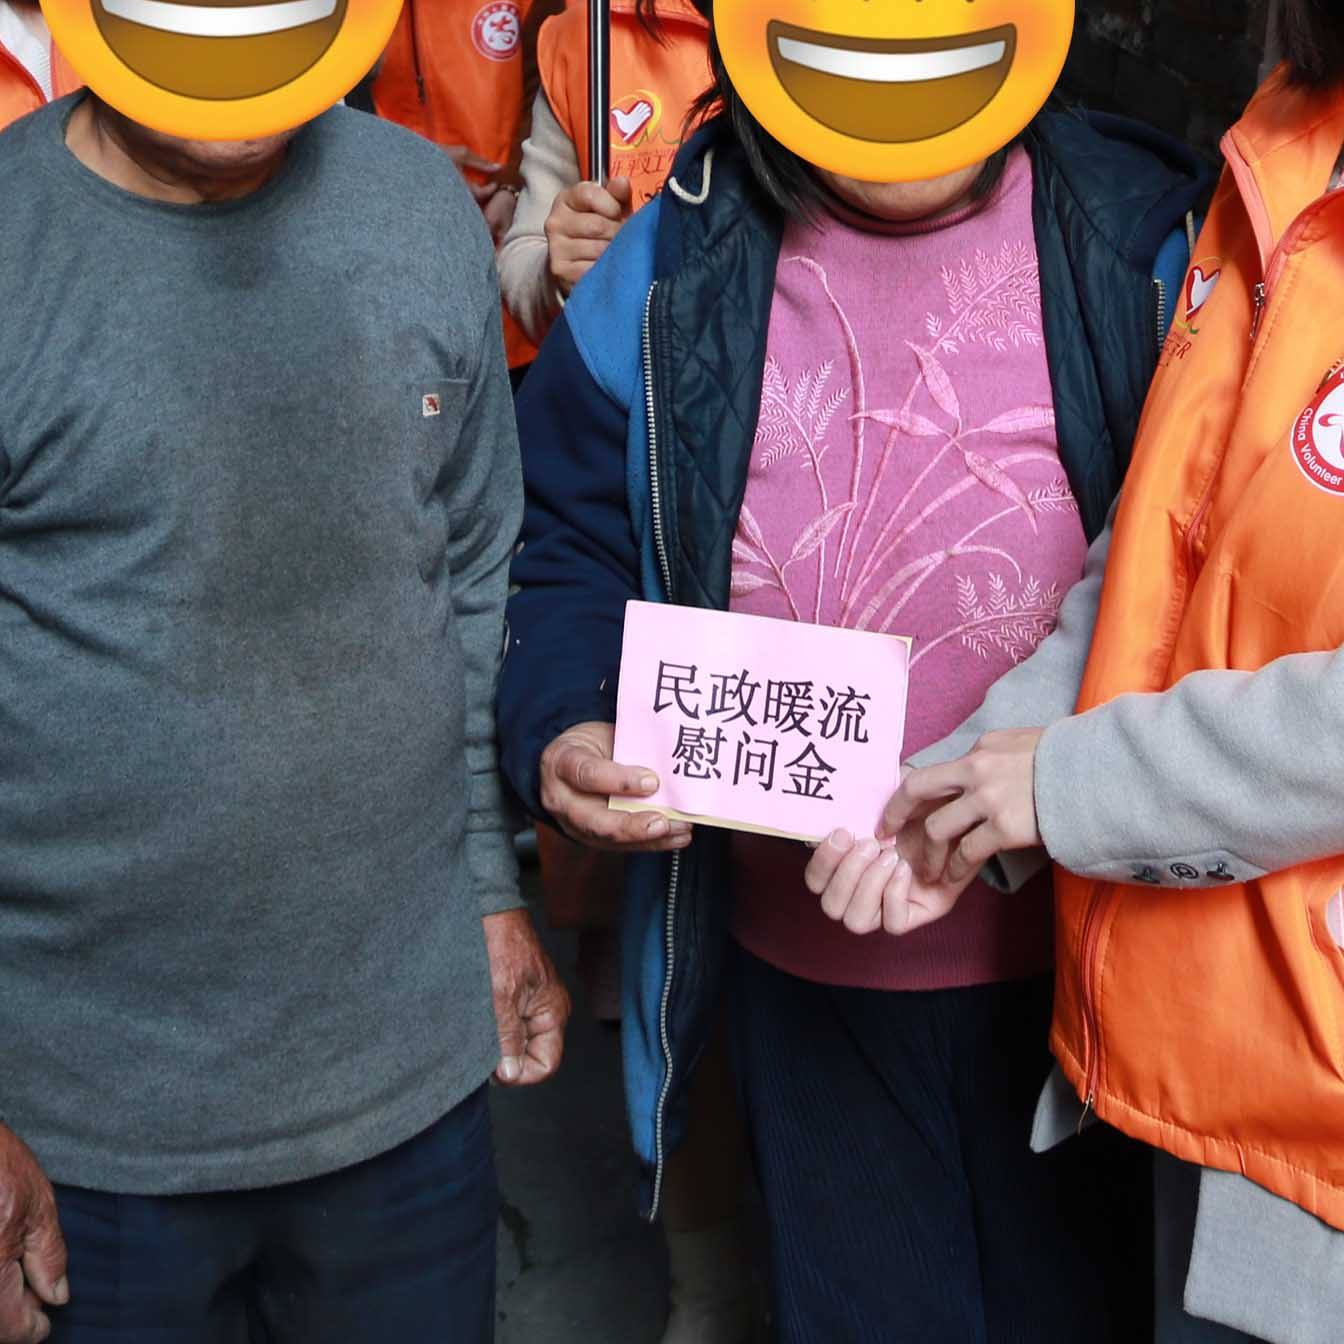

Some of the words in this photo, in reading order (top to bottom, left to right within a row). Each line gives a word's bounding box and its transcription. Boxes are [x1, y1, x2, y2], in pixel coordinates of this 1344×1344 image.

[1297, 407, 1314, 441] China
[1300, 442, 1343, 486] Volunteer
[652, 659, 871, 744] 民政暖流
[671, 723, 838, 802] 慰问金
